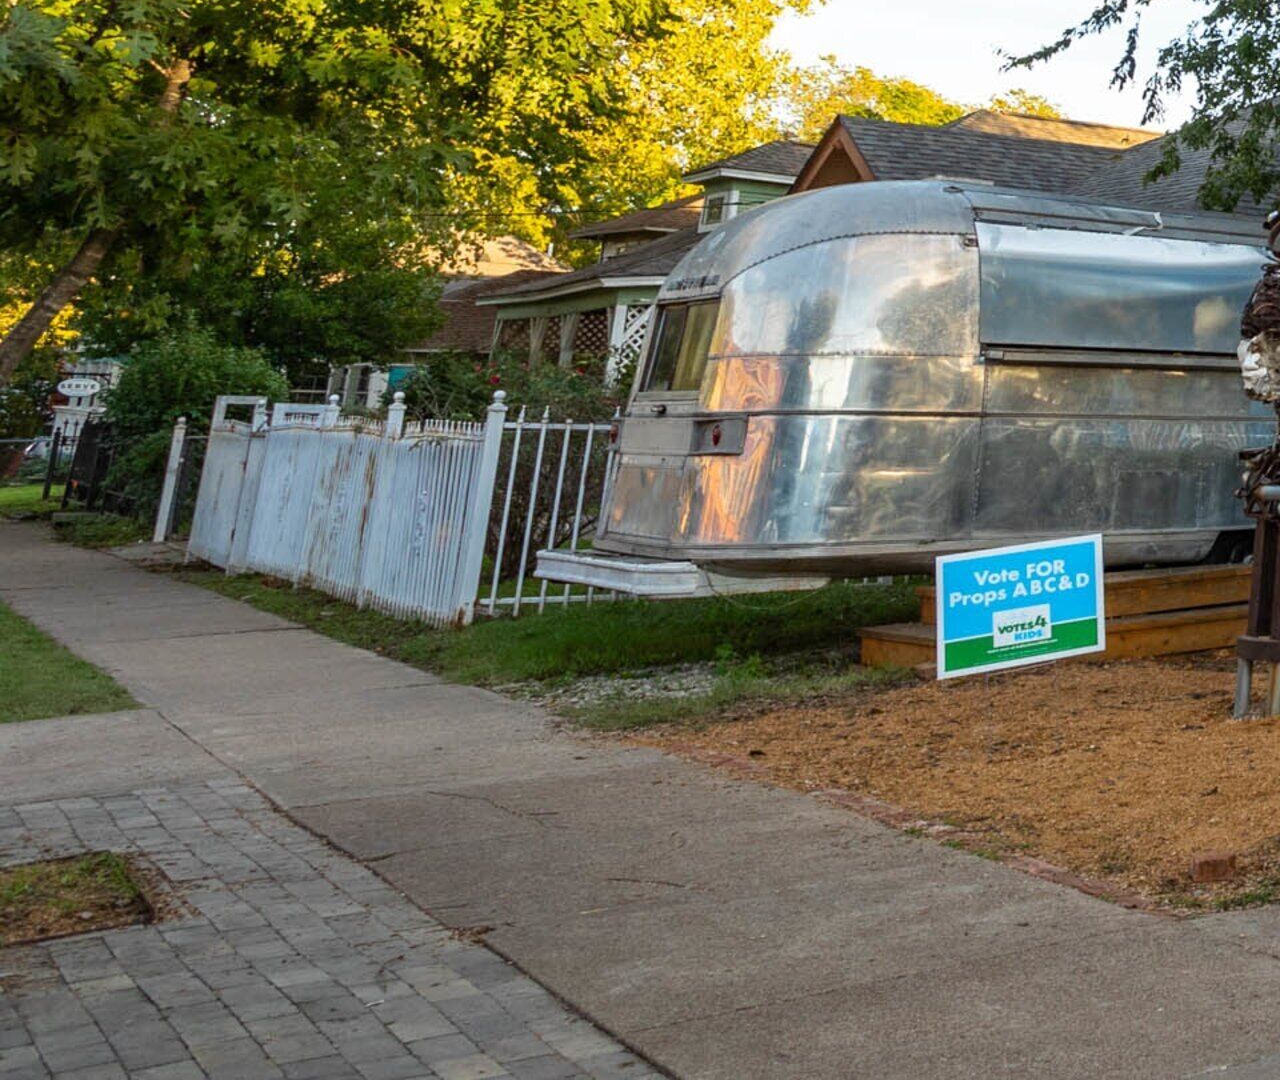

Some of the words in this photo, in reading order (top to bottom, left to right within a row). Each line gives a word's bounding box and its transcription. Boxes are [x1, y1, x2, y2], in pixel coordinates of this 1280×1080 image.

[974, 569, 1020, 586] Vote
[1026, 559, 1065, 579] FOR
[949, 587, 1007, 608] Props
[1014, 629, 1043, 641] KIDS
